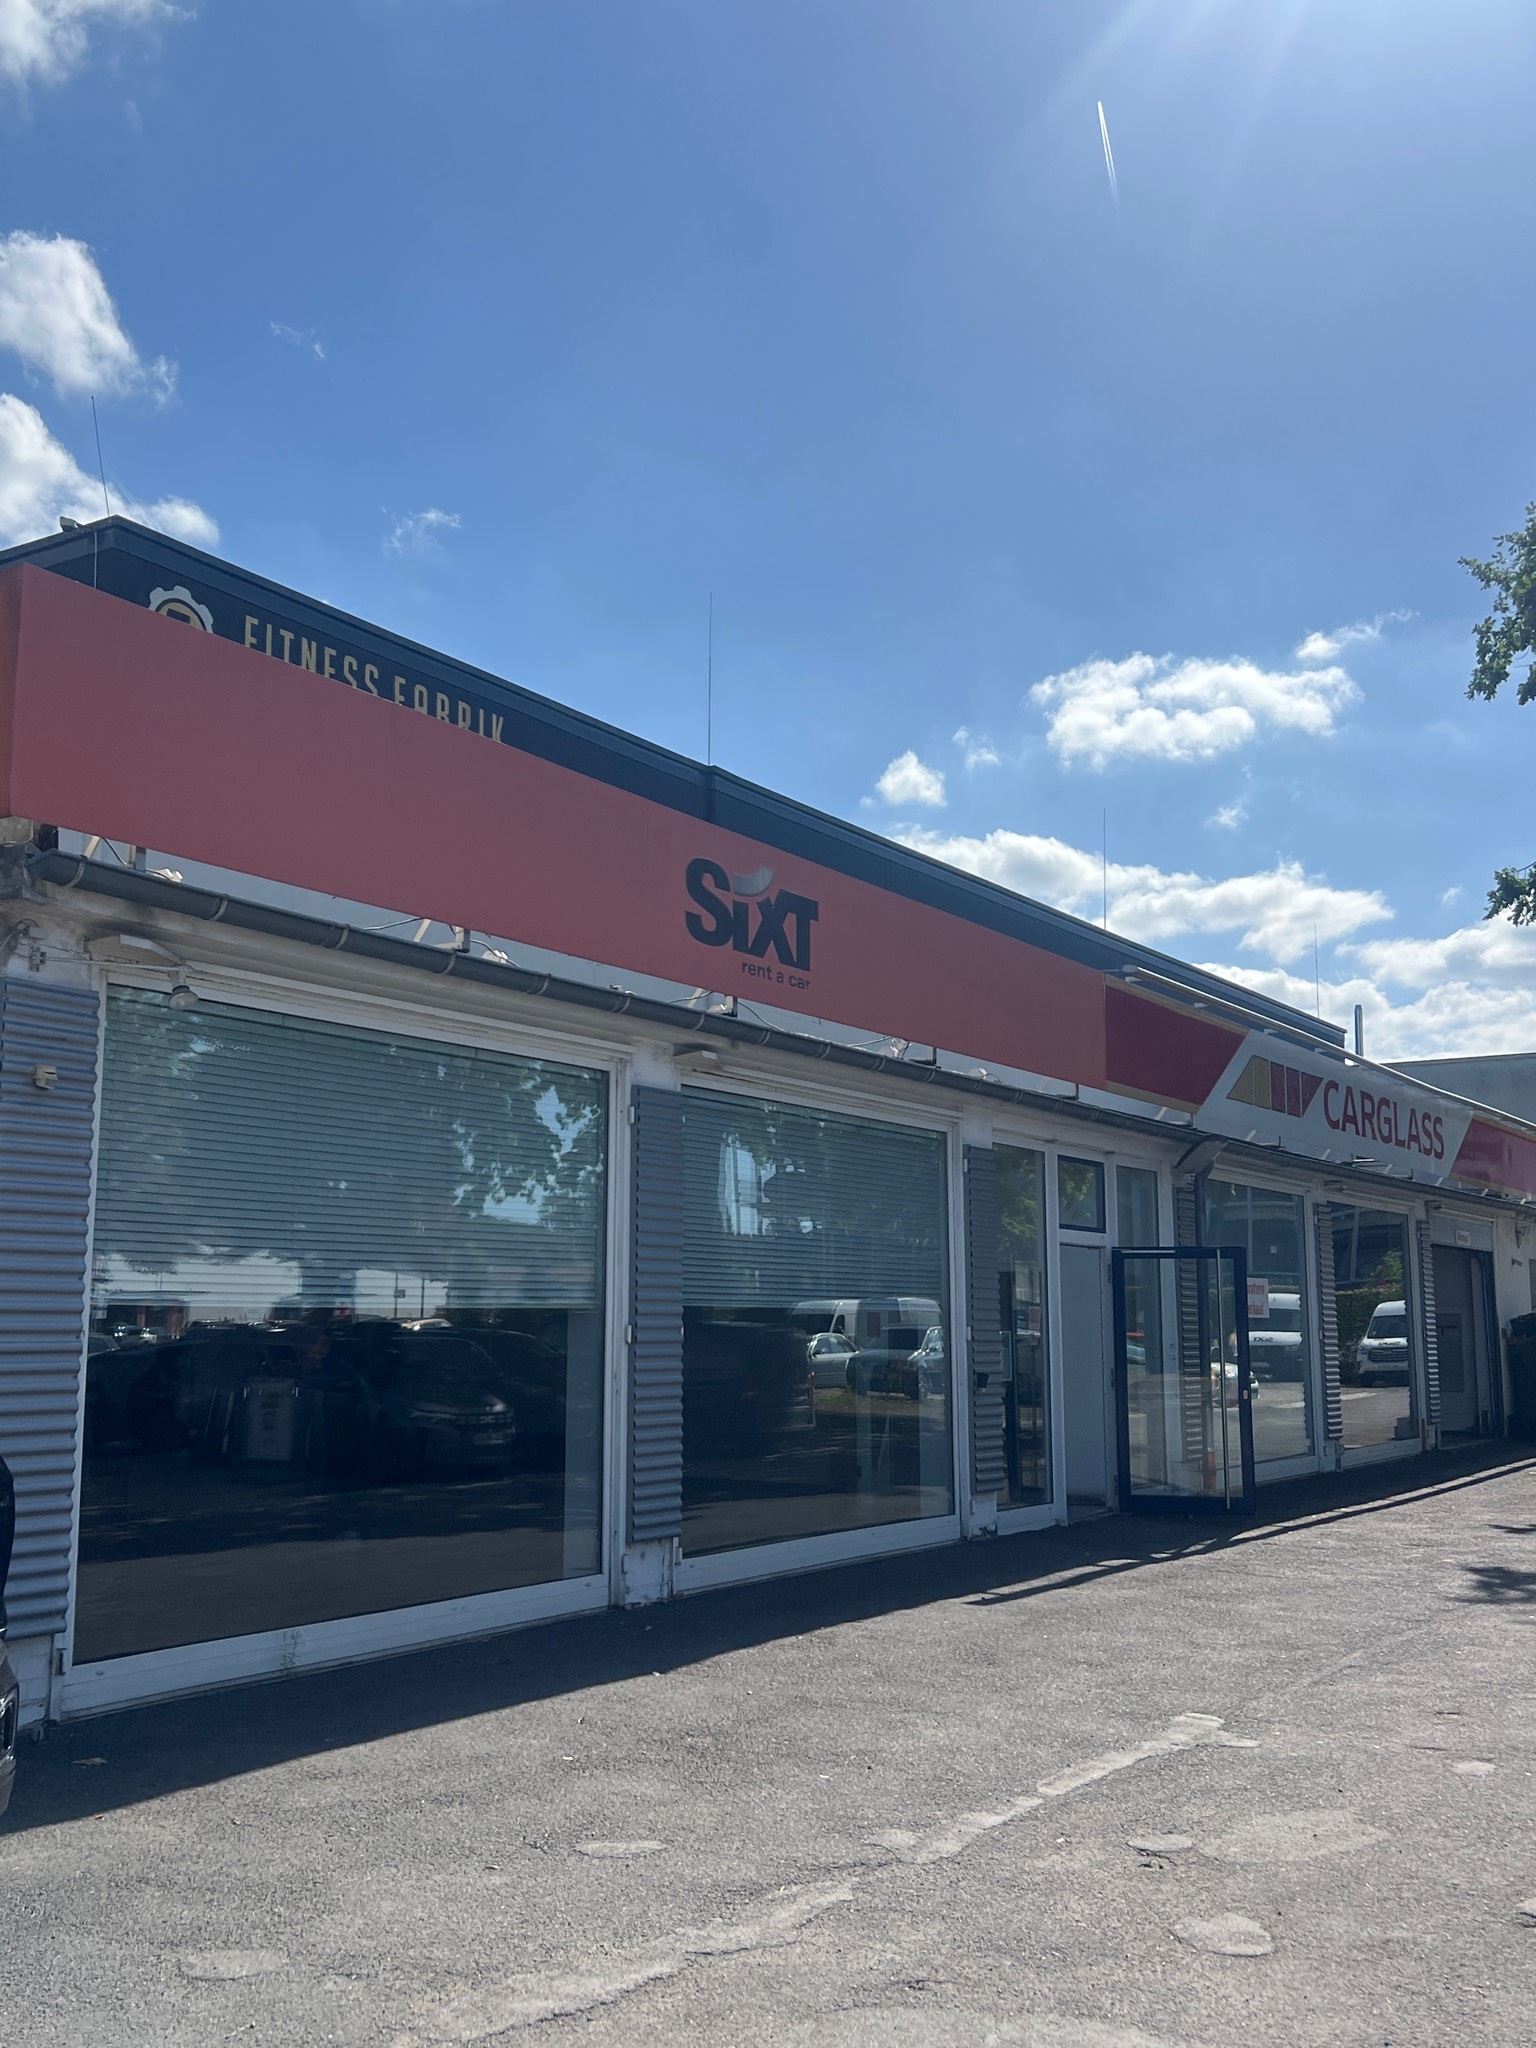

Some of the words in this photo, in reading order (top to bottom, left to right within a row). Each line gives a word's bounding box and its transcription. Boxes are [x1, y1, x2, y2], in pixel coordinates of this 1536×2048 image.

[245, 614, 379, 696] FITNESS
[742, 961, 772, 981] rent
[776, 971, 784, 984] a
[789, 975, 811, 991] car
[1323, 1079, 1445, 1160] CARGLASS
